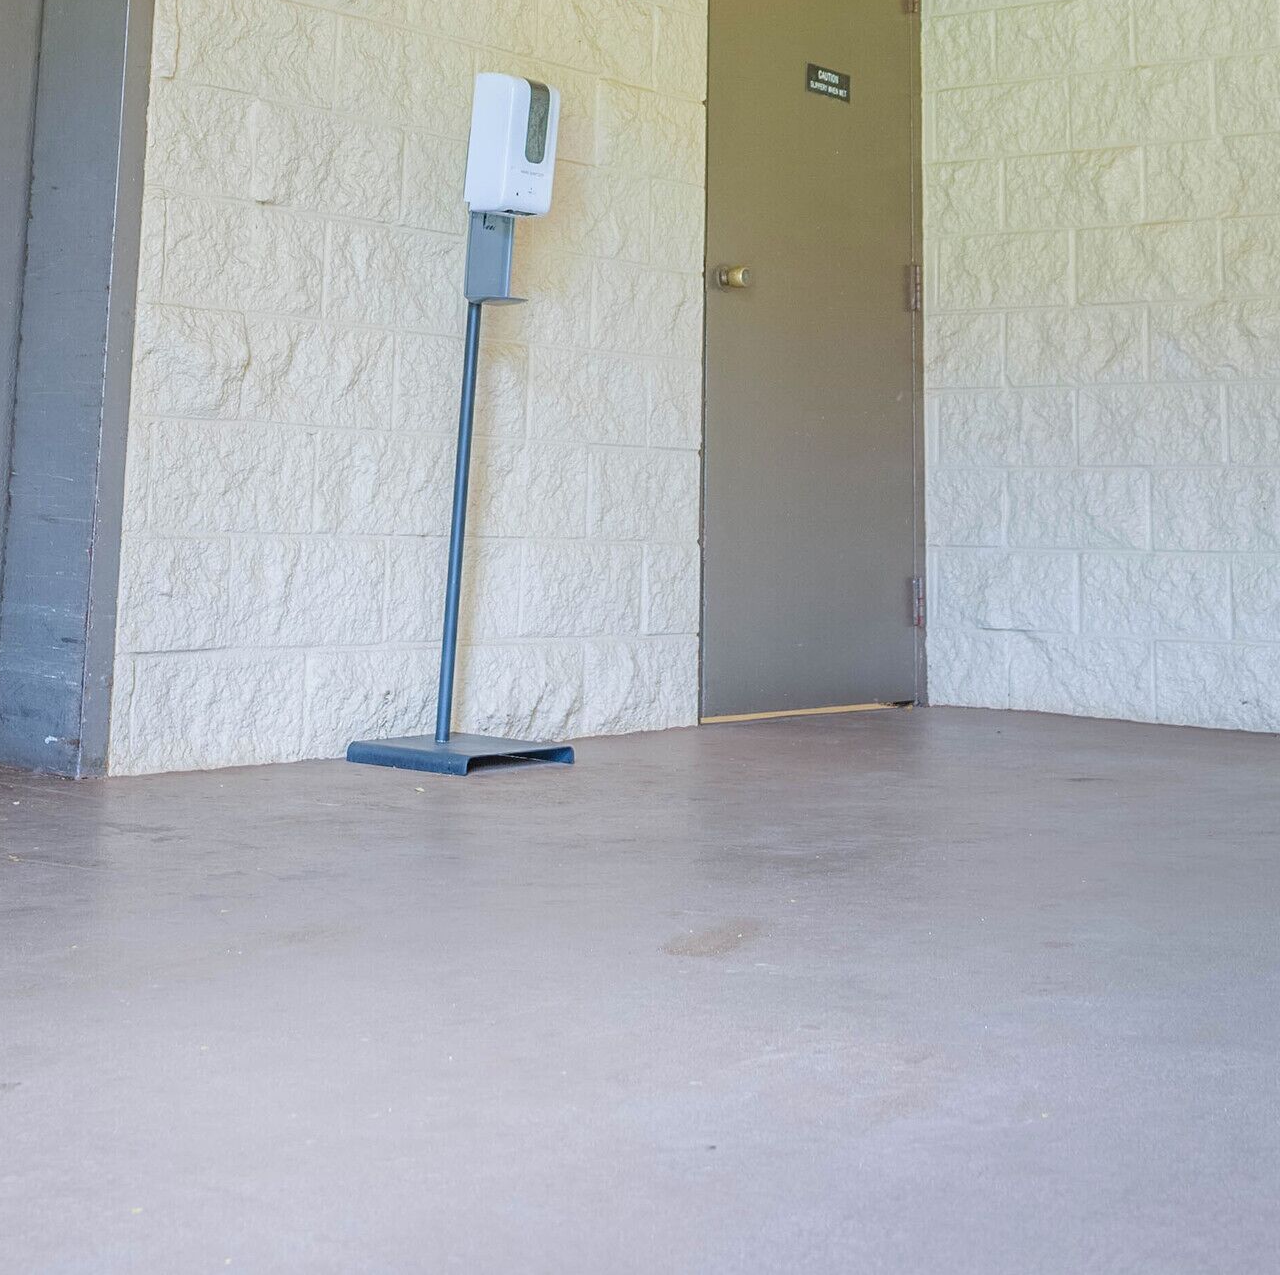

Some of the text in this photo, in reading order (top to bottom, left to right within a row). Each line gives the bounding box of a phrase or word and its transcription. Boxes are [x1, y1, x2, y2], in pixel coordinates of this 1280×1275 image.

[817, 69, 839, 85] CAUTION
[809, 80, 848, 98] SLIPPERY WHEN WET
